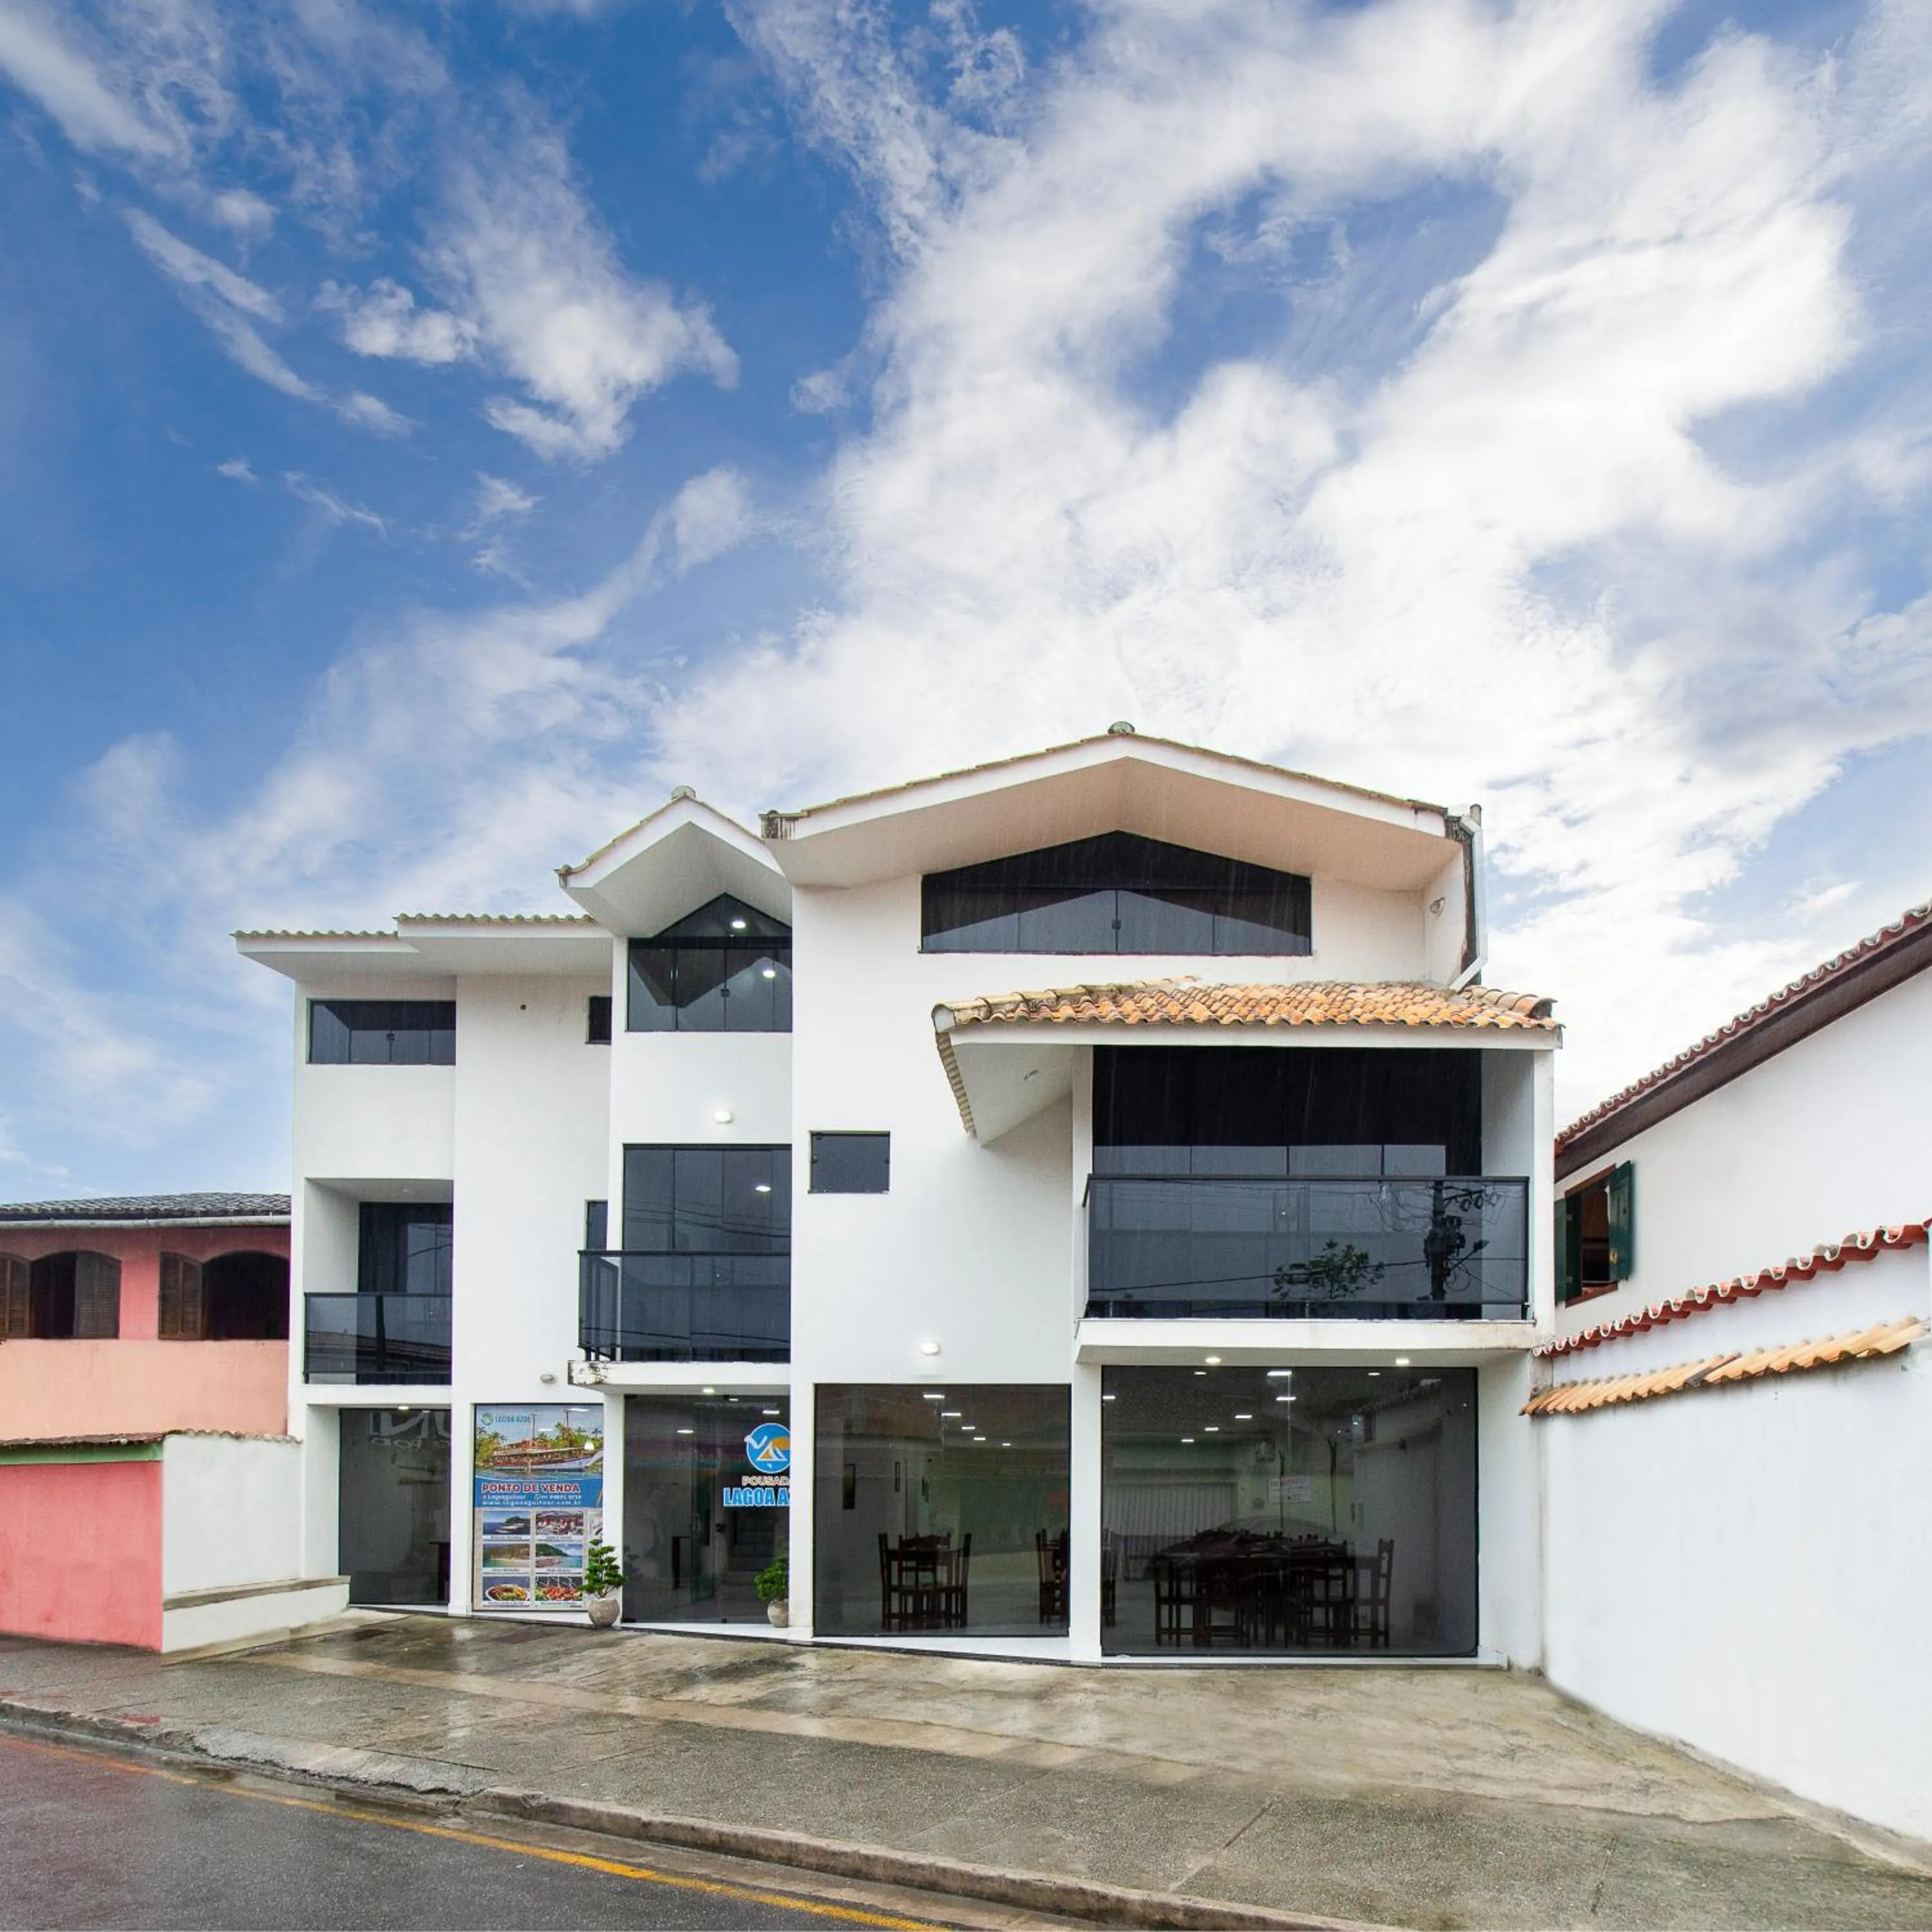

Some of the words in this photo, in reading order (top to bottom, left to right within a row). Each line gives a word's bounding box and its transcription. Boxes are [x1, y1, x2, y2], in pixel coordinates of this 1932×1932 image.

[741, 1475, 790, 1486] POUSAD
[482, 1484, 521, 1493] PONTO
[523, 1484, 538, 1493] DE
[542, 1484, 581, 1493] VENDA
[723, 1487, 775, 1506] LAGOA
[777, 1487, 790, 1506] A
